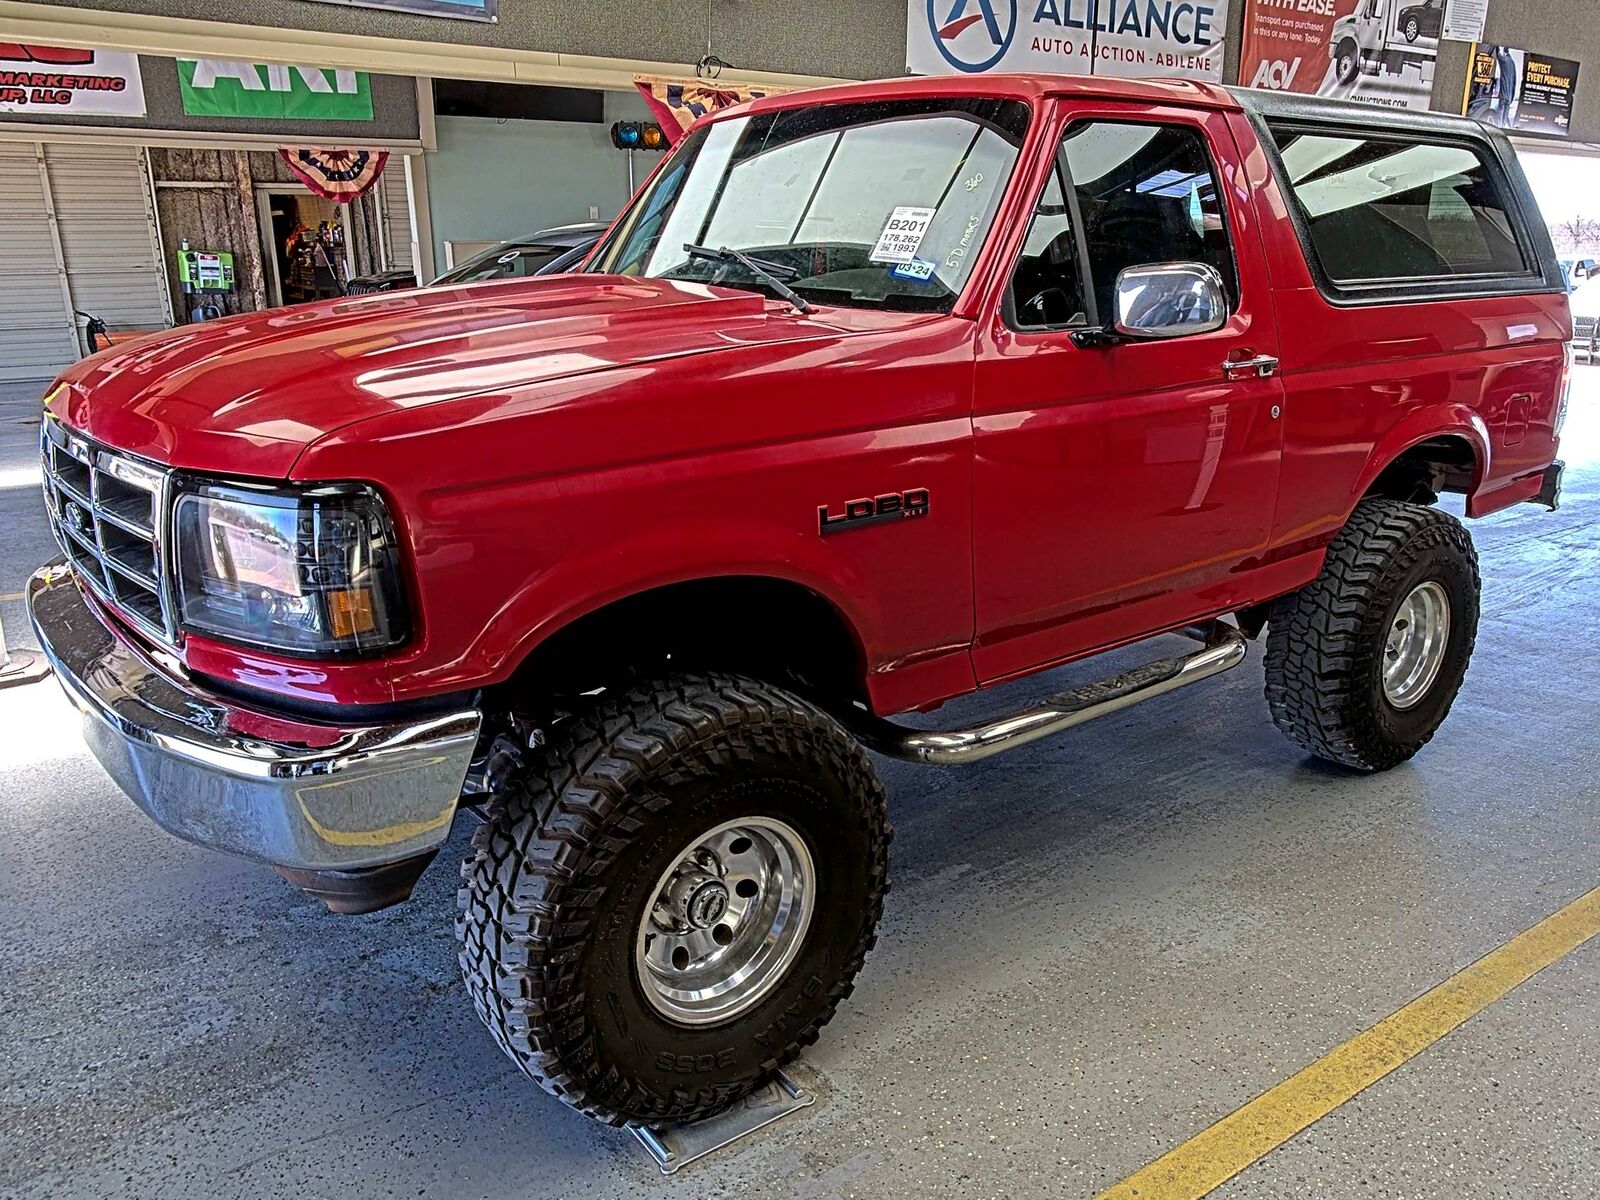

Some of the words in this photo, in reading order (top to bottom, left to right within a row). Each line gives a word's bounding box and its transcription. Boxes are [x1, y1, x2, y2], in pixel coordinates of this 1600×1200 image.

[1033, 0, 1214, 46] ALLIANCE
[1254, 12, 1281, 25] Transport
[1281, 19, 1294, 27] cars
[1294, 20, 1324, 32] purchased
[1253, 26, 1259, 34] in
[1259, 27, 1271, 37] this
[1278, 31, 1289, 41] any
[1031, 37, 1073, 55] AUTO
[1080, 43, 1145, 64] AUCTION
[1250, 57, 1302, 90] ACV
[1527, 61, 1551, 74] PROTECT
[0, 71, 126, 92] MARKETING
[1526, 71, 1544, 84] EVERY
[30, 89, 72, 105] LLC
[888, 219, 926, 232] B201
[893, 243, 916, 253] 1993
[817, 487, 929, 531] LOBO
